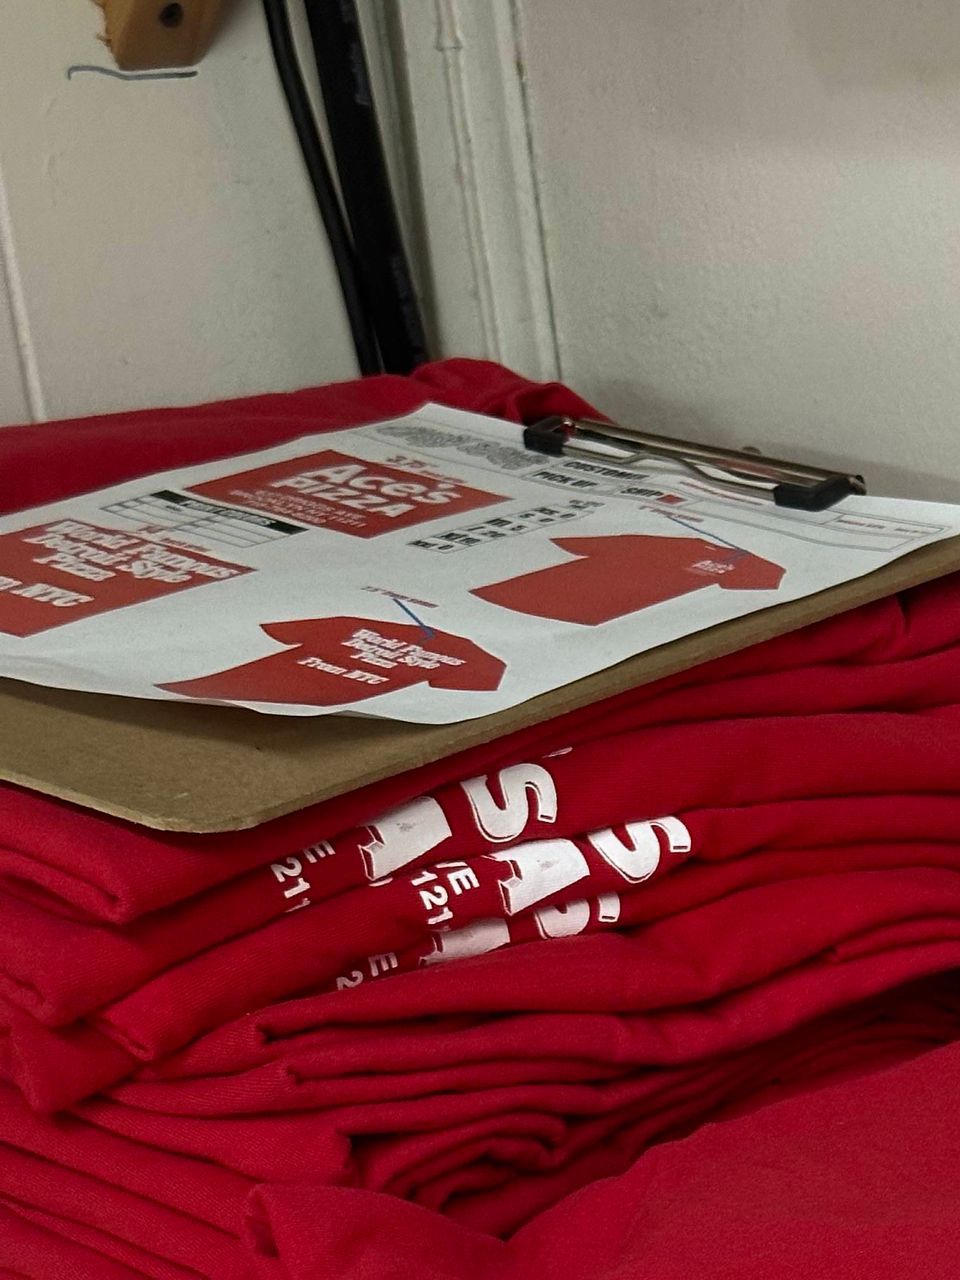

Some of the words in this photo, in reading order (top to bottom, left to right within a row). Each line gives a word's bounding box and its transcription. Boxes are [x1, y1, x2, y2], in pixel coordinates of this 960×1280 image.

[304, 464, 462, 504] Ace's
[533, 471, 574, 484] PICK
[620, 487, 664, 496] SHIP
[271, 476, 416, 518] PIZZA
[23, 533, 129, 565] Detroit
[117, 559, 192, 583] Style
[46, 520, 139, 549] World
[123, 545, 241, 578] Famous
[33, 552, 116, 581] Pizza
[15, 583, 94, 607] NYC
[341, 639, 403, 660] Detroit
[397, 656, 440, 669] Style
[350, 652, 398, 668] Pizza
[352, 629, 407, 649] World
[401, 645, 467, 666] Famous
[297, 657, 348, 675] From
[343, 670, 390, 685] NYC
